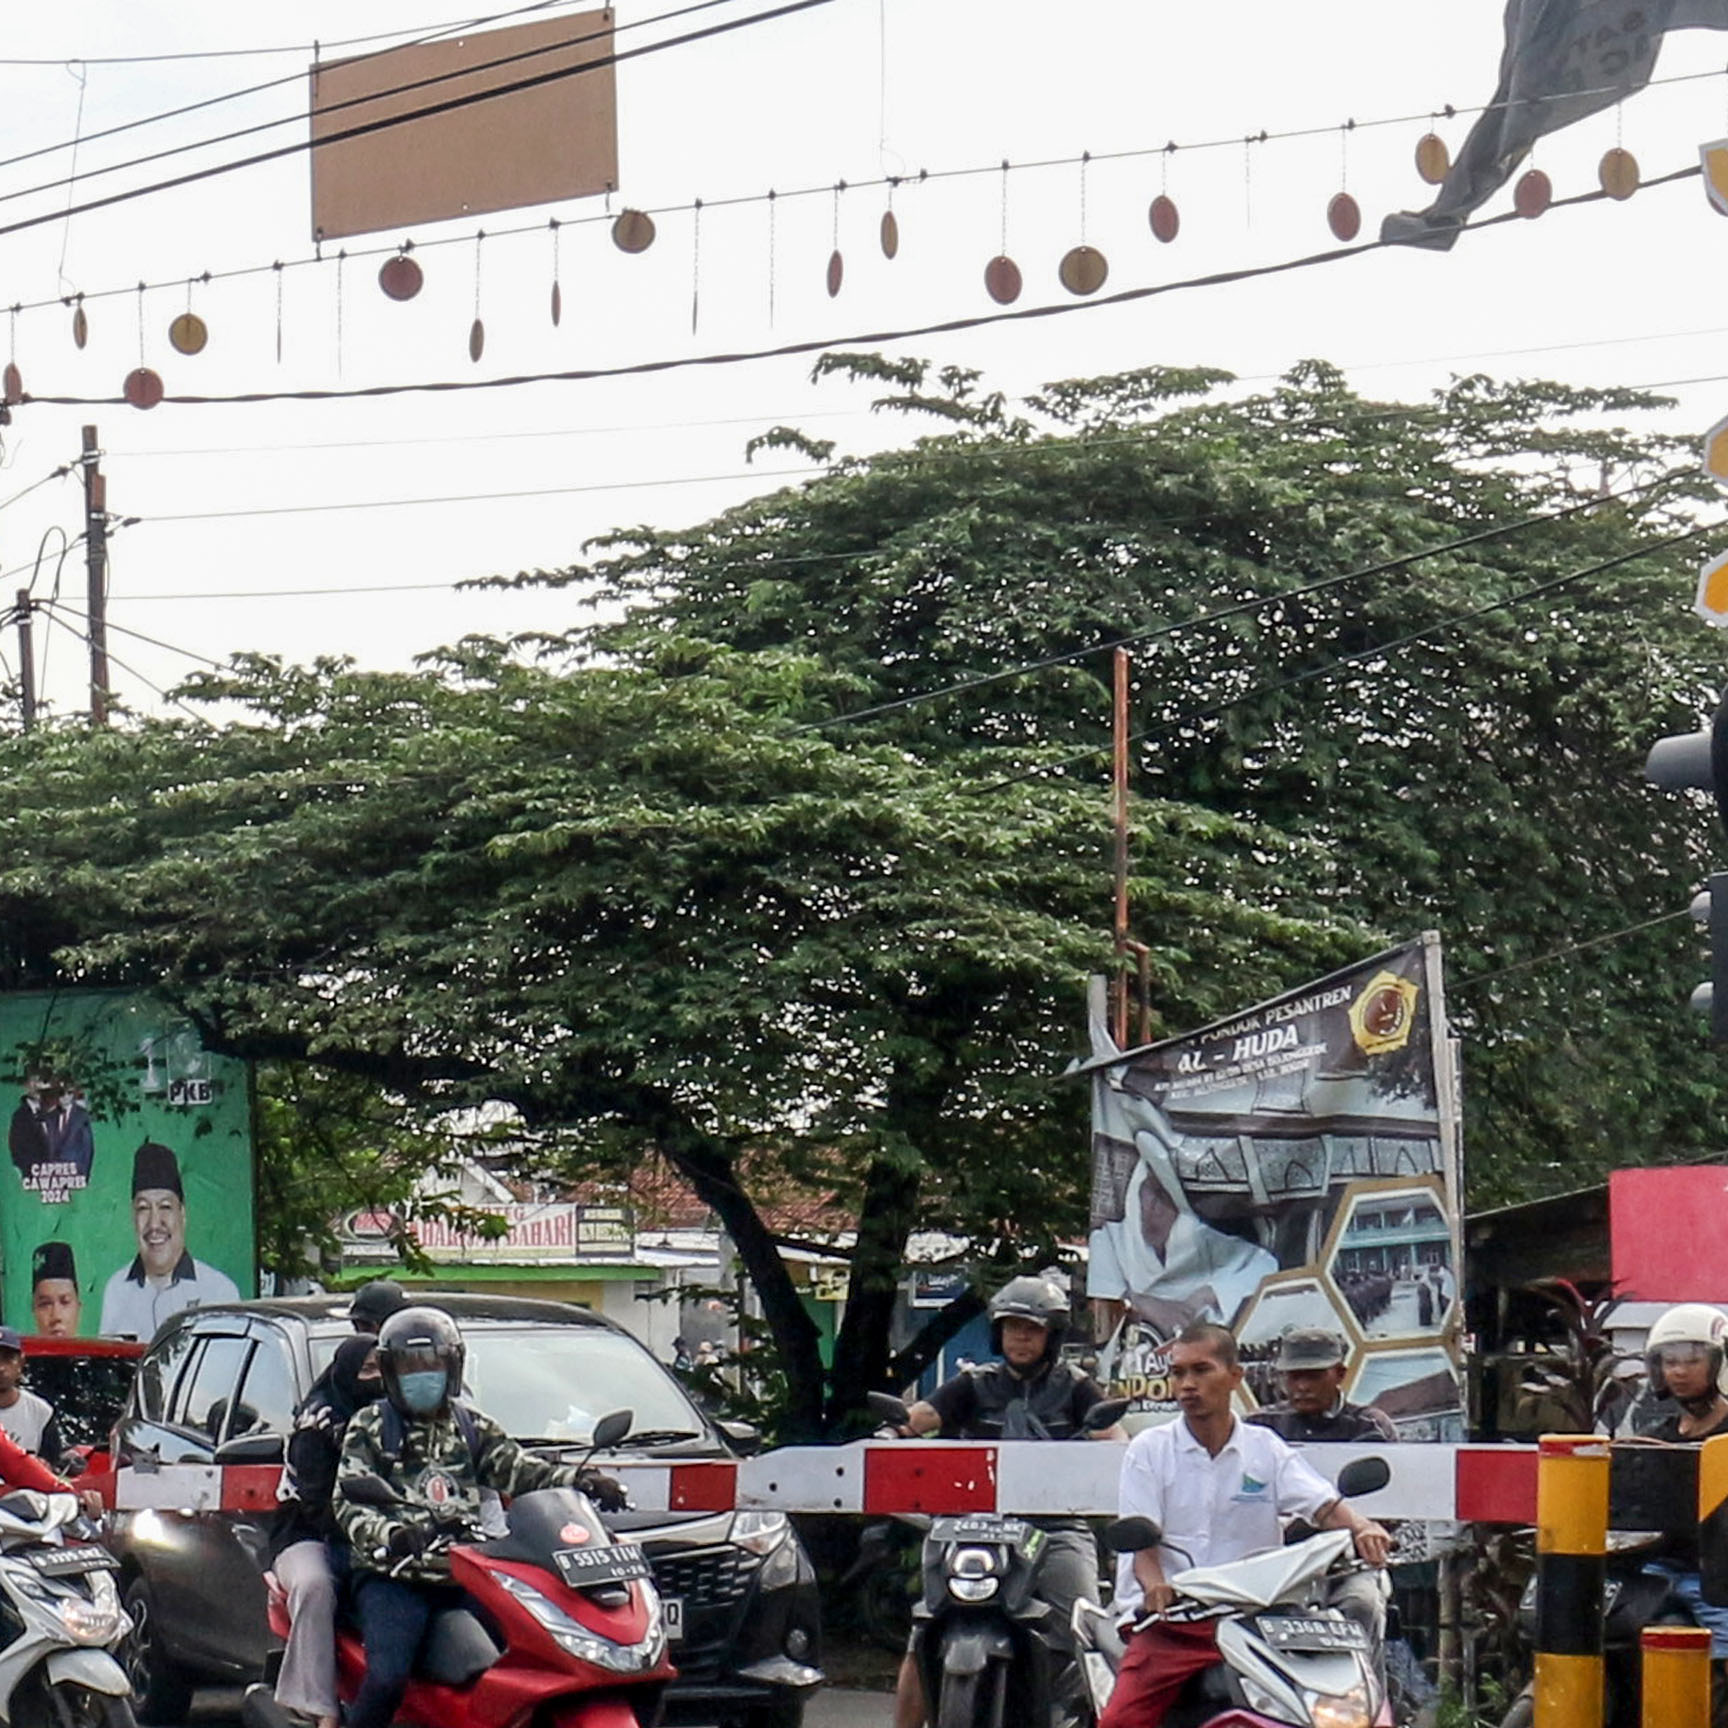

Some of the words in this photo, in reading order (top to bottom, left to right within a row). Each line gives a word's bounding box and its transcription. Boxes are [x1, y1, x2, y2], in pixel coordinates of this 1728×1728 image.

[1265, 986, 1353, 1025] PESANTREN
[1232, 1024, 1298, 1061] HUDA
[170, 1081, 211, 1103] PKB
[31, 1162, 77, 1176] CAPRES
[41, 1190, 70, 1203] 2024
[559, 1555, 571, 1570] B
[573, 1550, 611, 1567] 5515
[1263, 1620, 1274, 1633] B
